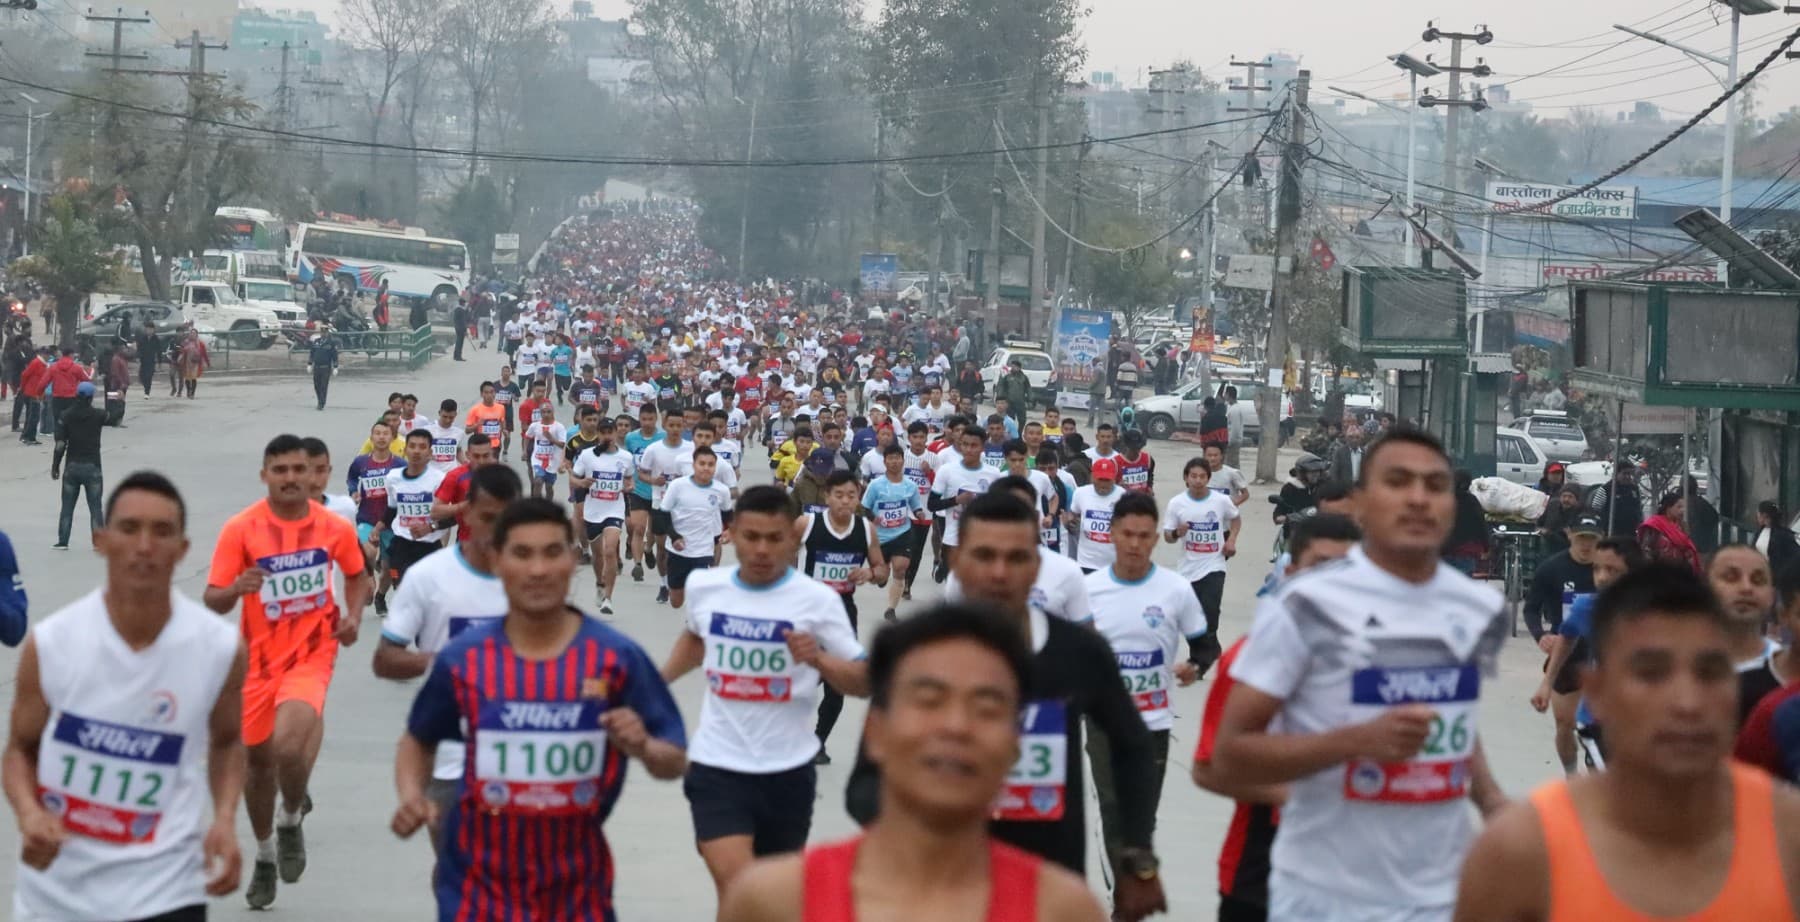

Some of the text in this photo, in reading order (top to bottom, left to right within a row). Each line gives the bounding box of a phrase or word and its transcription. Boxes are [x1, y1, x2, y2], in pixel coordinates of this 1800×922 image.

[434, 446, 455, 454] 1080
[595, 481, 620, 490] 1043
[400, 504, 430, 515] 1133
[884, 511, 902, 520] 063
[1190, 532, 1217, 543] 1034
[820, 565, 855, 580] 100
[267, 569, 325, 597] 1084
[721, 616, 777, 640] सफल
[715, 643, 787, 673] 1006
[500, 700, 584, 729] सफल
[493, 740, 595, 776] 1100
[60, 754, 164, 807] 1112
